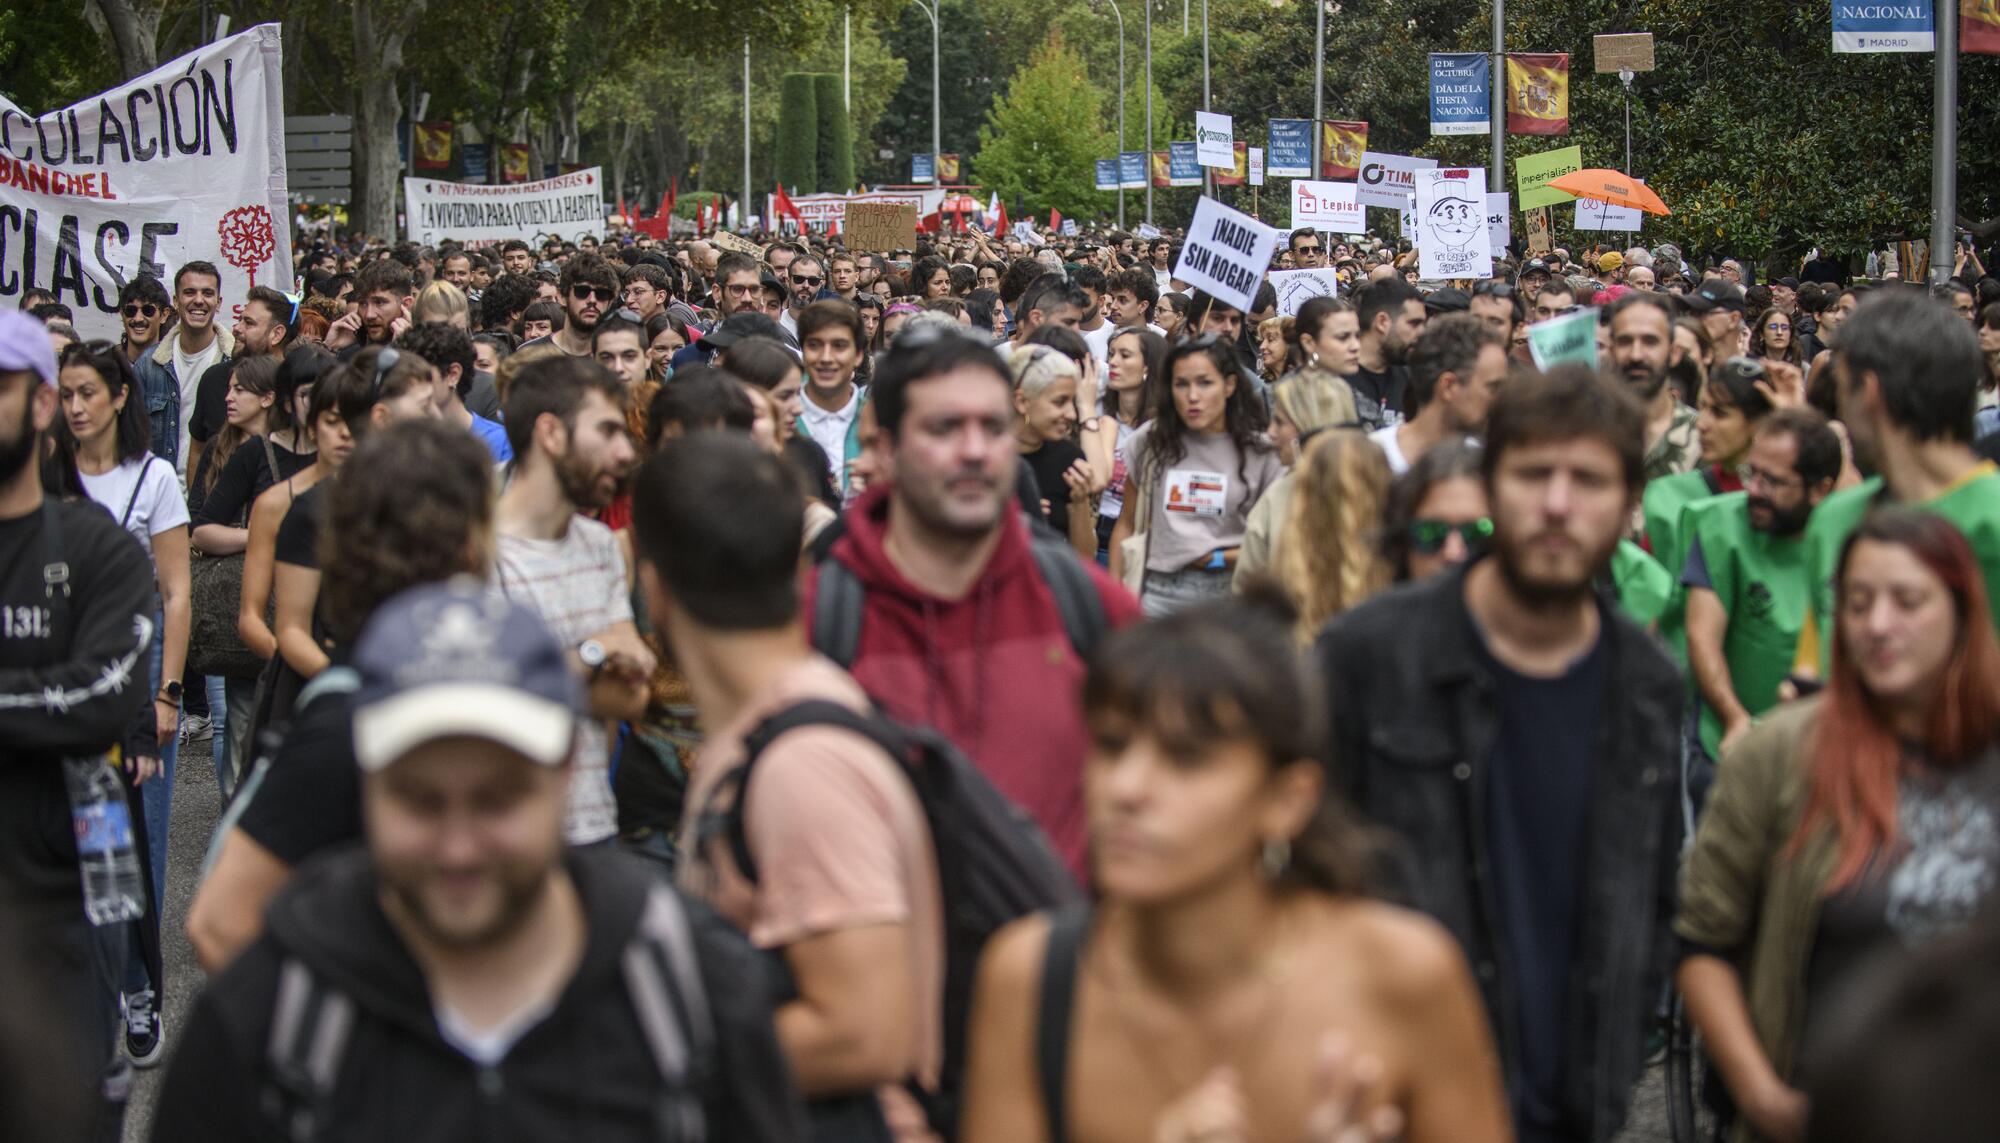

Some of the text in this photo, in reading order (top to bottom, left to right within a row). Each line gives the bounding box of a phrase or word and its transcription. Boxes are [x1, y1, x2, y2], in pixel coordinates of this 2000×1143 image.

[1842, 6, 1926, 18] NACIONAL
[1435, 84, 1482, 93] DÍA DE LA
[1436, 96, 1467, 104] FIESTA
[0, 56, 238, 166] CULACIÓN
[1436, 106, 1486, 115] NACIONAL
[1322, 198, 1359, 211] tepiso
[421, 194, 604, 231] LA VIVIENDA PARA QUIEN LA HABITA
[1184, 242, 1212, 274] SIN
[1209, 254, 1258, 298] HOGAR!
